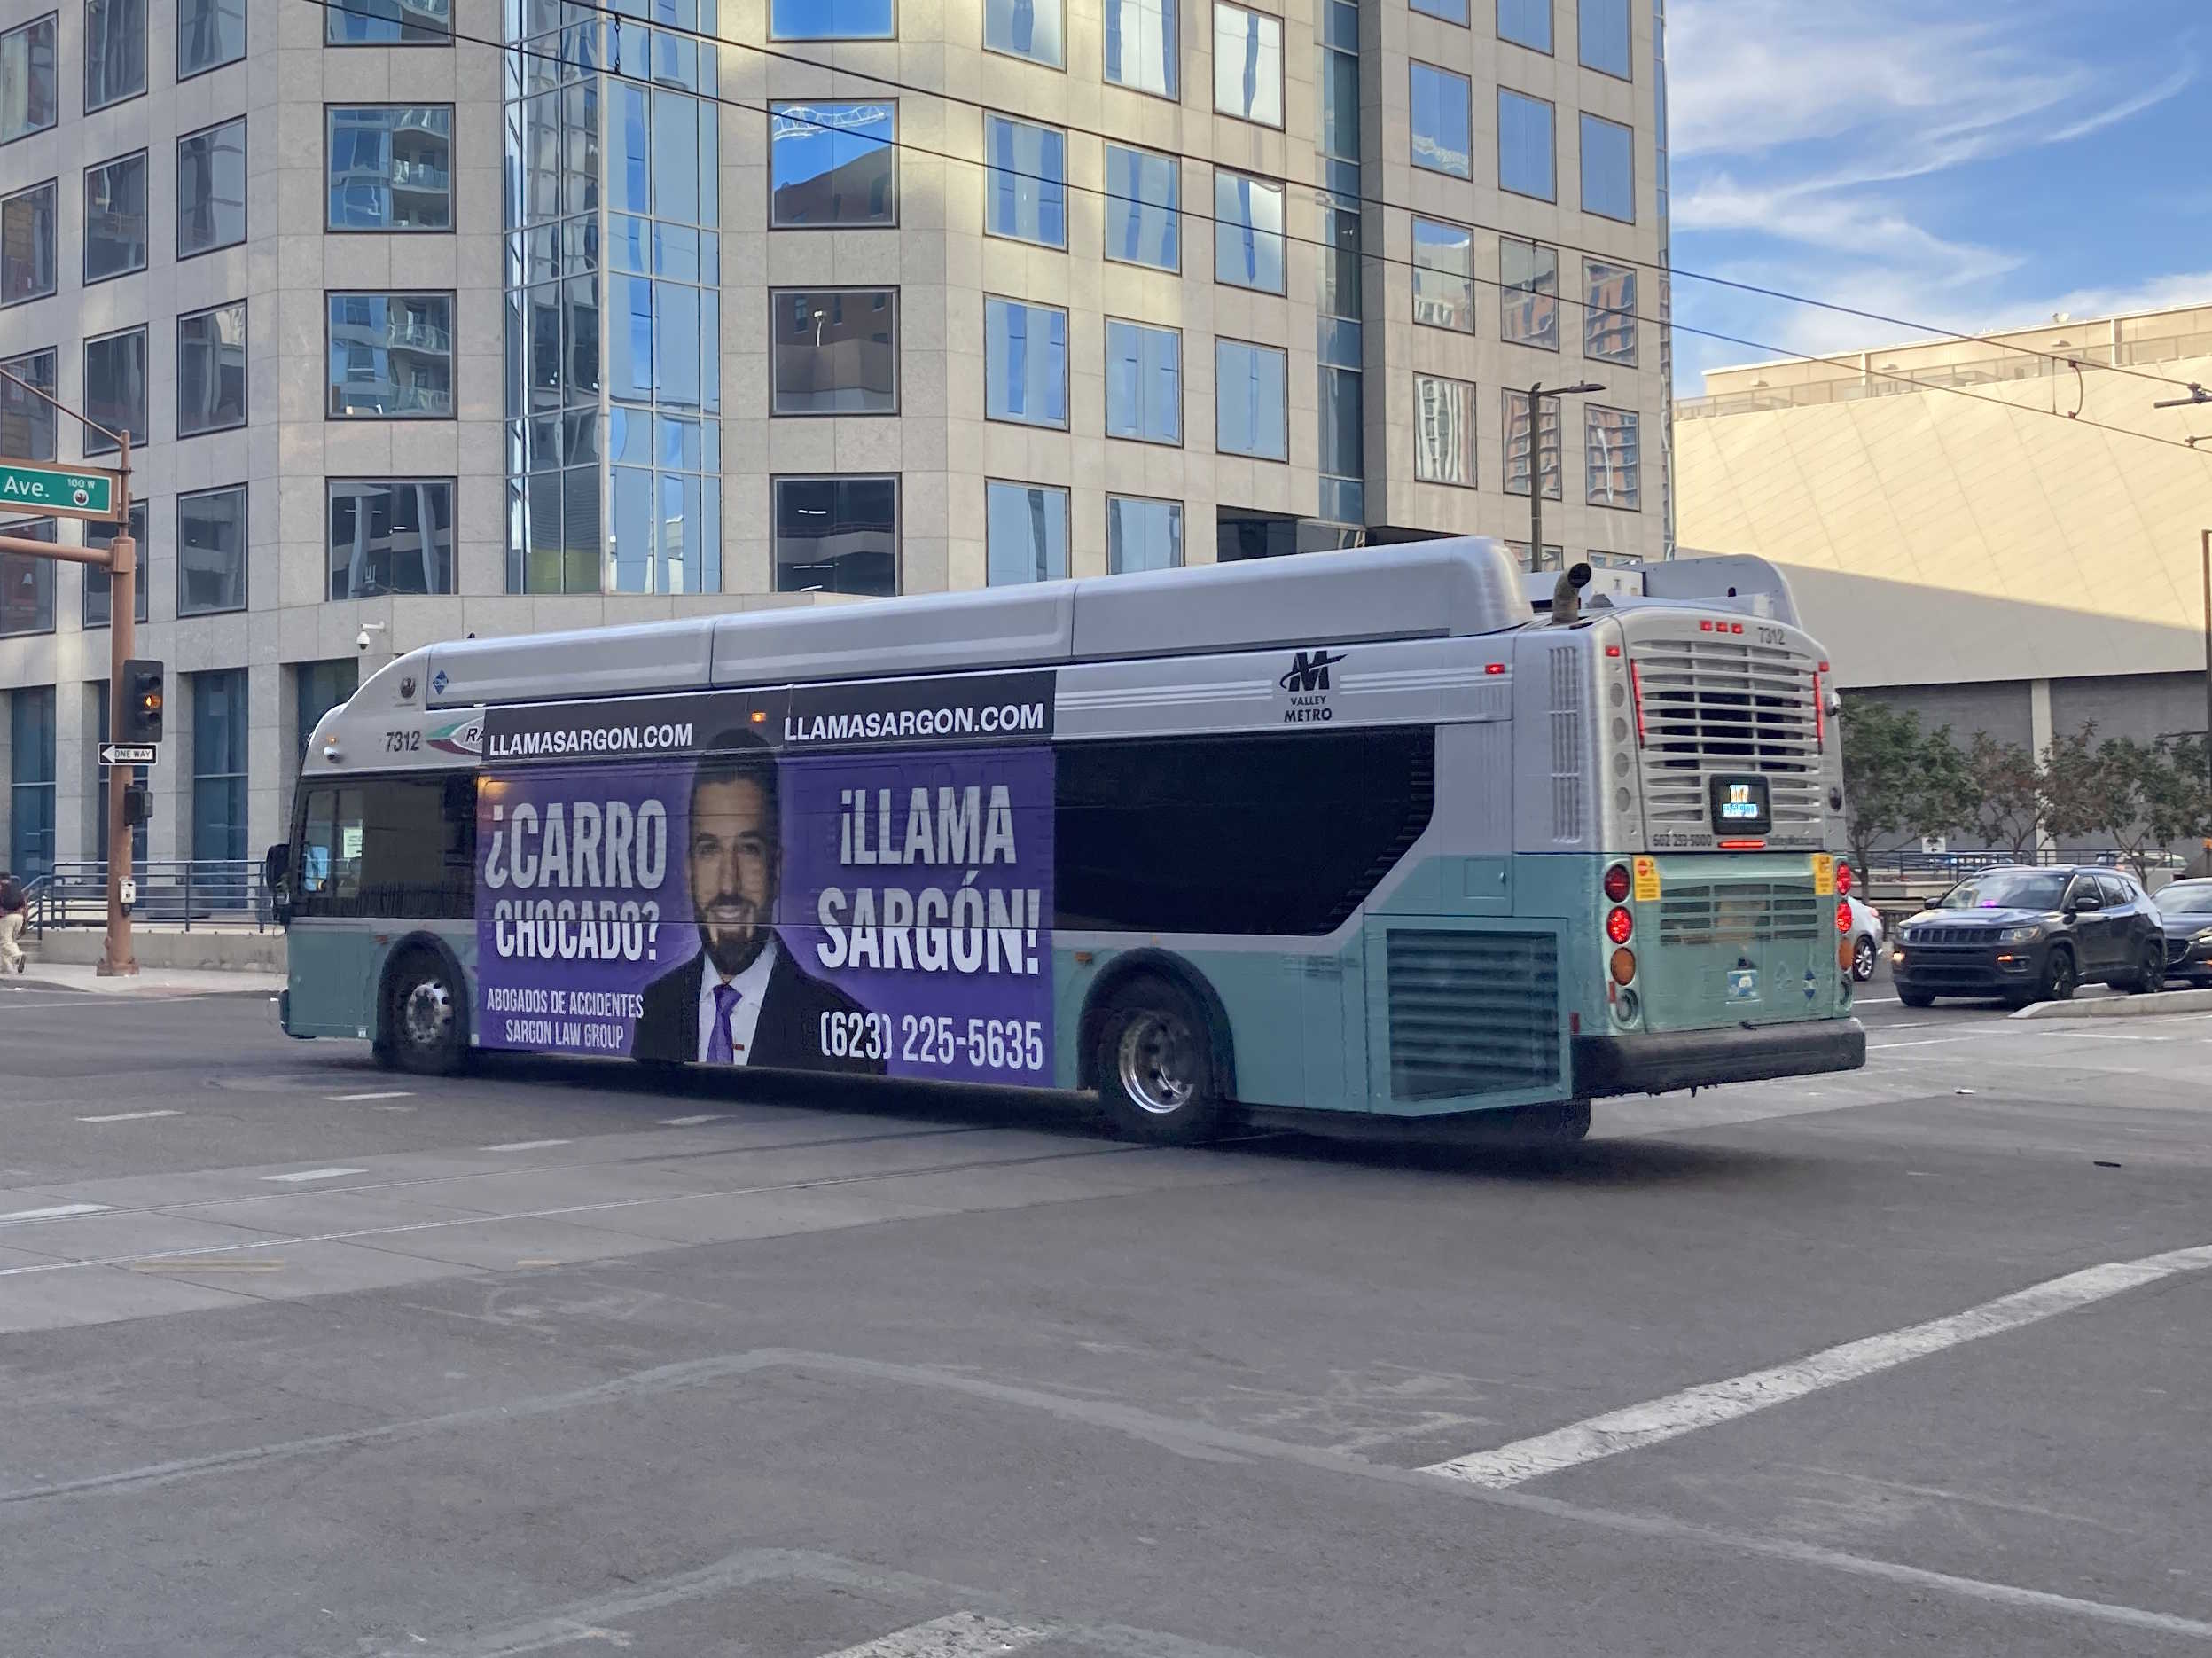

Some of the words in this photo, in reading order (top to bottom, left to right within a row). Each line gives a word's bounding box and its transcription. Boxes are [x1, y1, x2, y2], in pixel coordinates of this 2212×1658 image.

[4, 475, 50, 497] Ave.
[67, 479, 85, 488] 100
[1757, 626, 1786, 645] 7312
[1284, 708, 1333, 723] METRO
[1291, 695, 1326, 706] VALLEY
[784, 703, 1044, 741] LLAMASARGON.COM
[386, 730, 420, 752] 7312
[489, 723, 693, 756] LLAMASARGON.COM
[840, 785, 1017, 864] ¡LLAMA
[485, 799, 667, 890] ¿CARRO
[494, 898, 660, 961] CHOCADO?
[817, 870, 1041, 974] SARGÓN!
[487, 988, 548, 1013] ABOGADOS
[551, 991, 567, 1014] DE
[569, 992, 645, 1019] ACCIDENTES
[506, 1019, 553, 1044] SARGON
[555, 1021, 582, 1046] LAW
[583, 1023, 624, 1049] GROUP
[820, 1011, 893, 1060] (623)
[902, 1014, 1043, 1071] 225-5635
